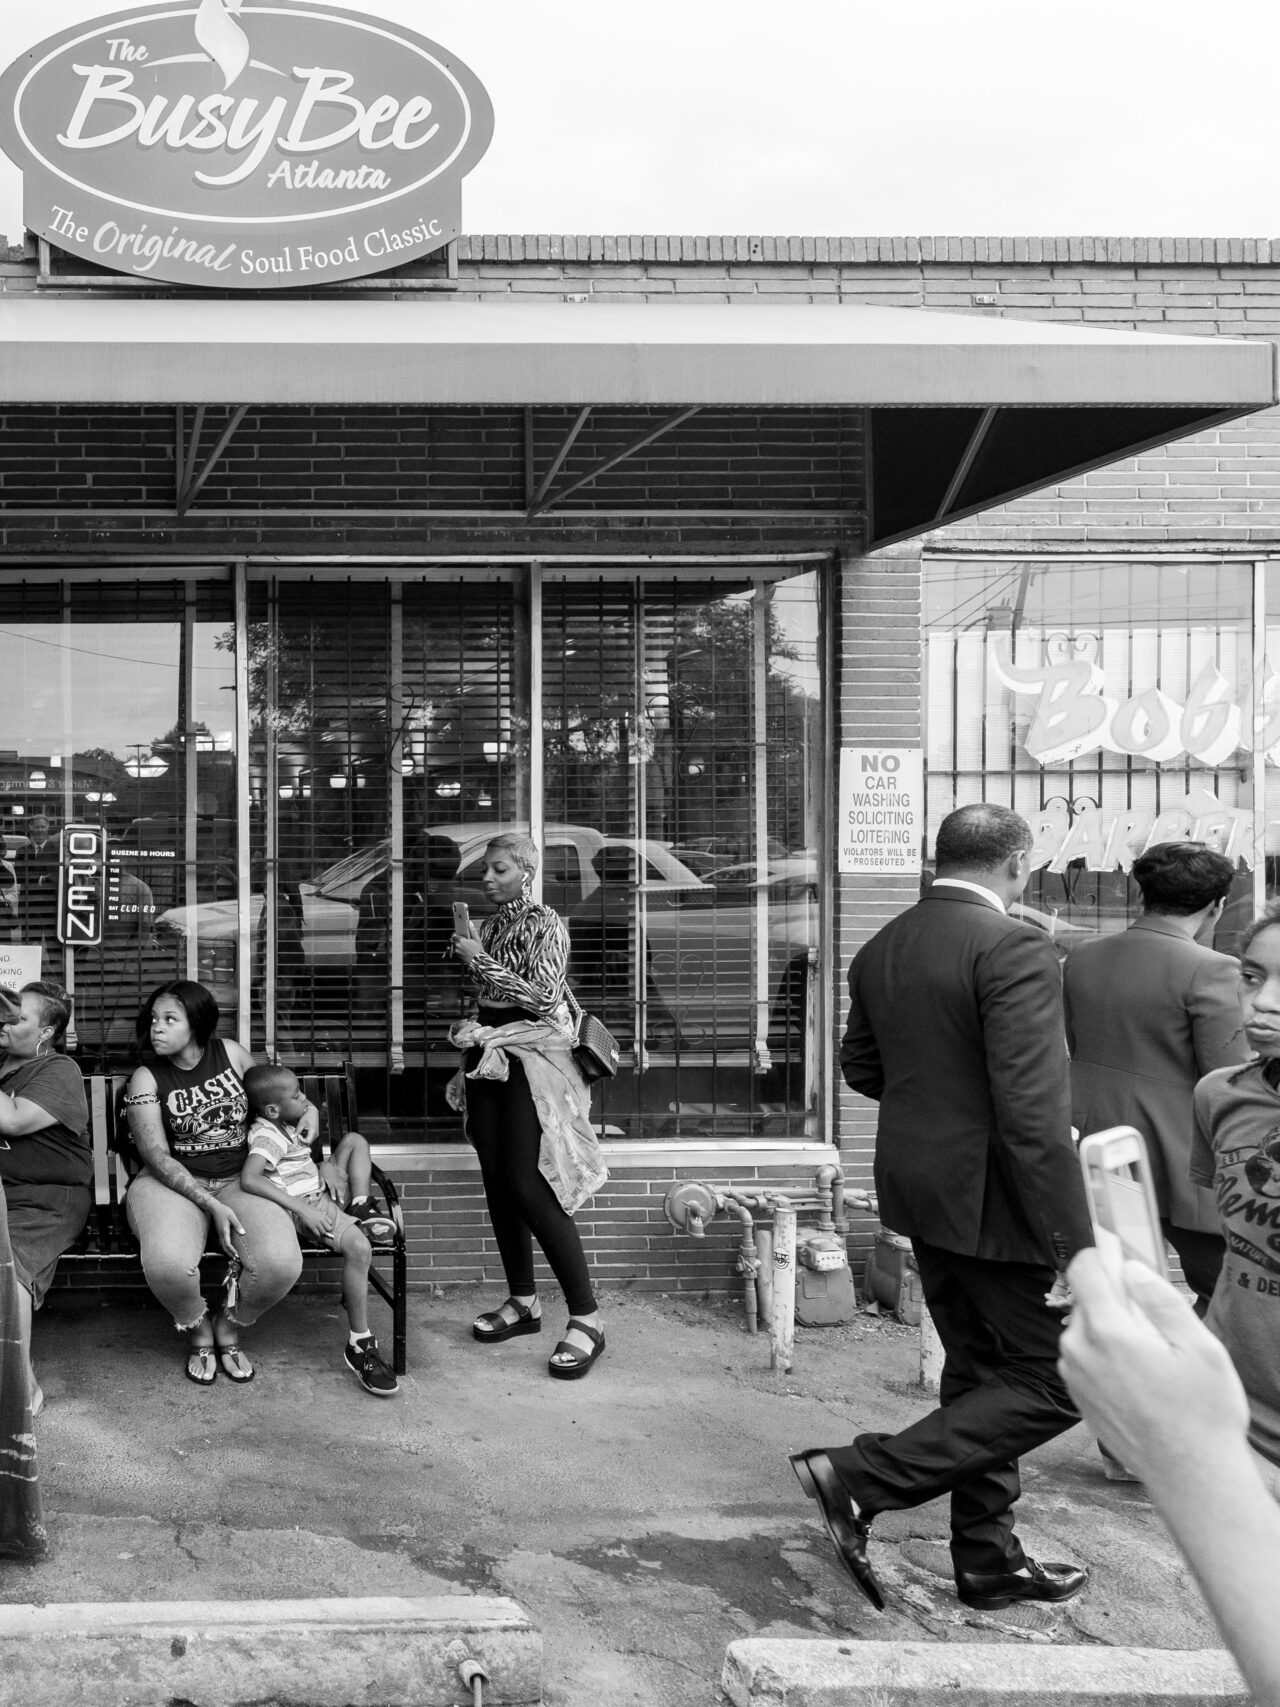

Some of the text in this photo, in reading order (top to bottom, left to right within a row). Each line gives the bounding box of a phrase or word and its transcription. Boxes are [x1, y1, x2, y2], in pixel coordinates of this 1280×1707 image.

[105, 38, 148, 62] The
[56, 63, 440, 186] Busy Bee
[267, 160, 391, 190] Atlanta
[48, 204, 443, 276] The Original Soul Food Classic
[861, 754, 900, 773] NO
[865, 776, 897, 790] CAR
[852, 793, 910, 807] WASHING
[848, 811, 913, 825] SOLICITING
[850, 829, 910, 844] LOITERING
[843, 848, 917, 856] VIOLATORS WILL BE
[854, 858, 905, 866] PROSECUTED
[66, 832, 97, 938] OPEN
[166, 1067, 244, 1116] CASH
[1256, 1276, 1280, 1297] DE
